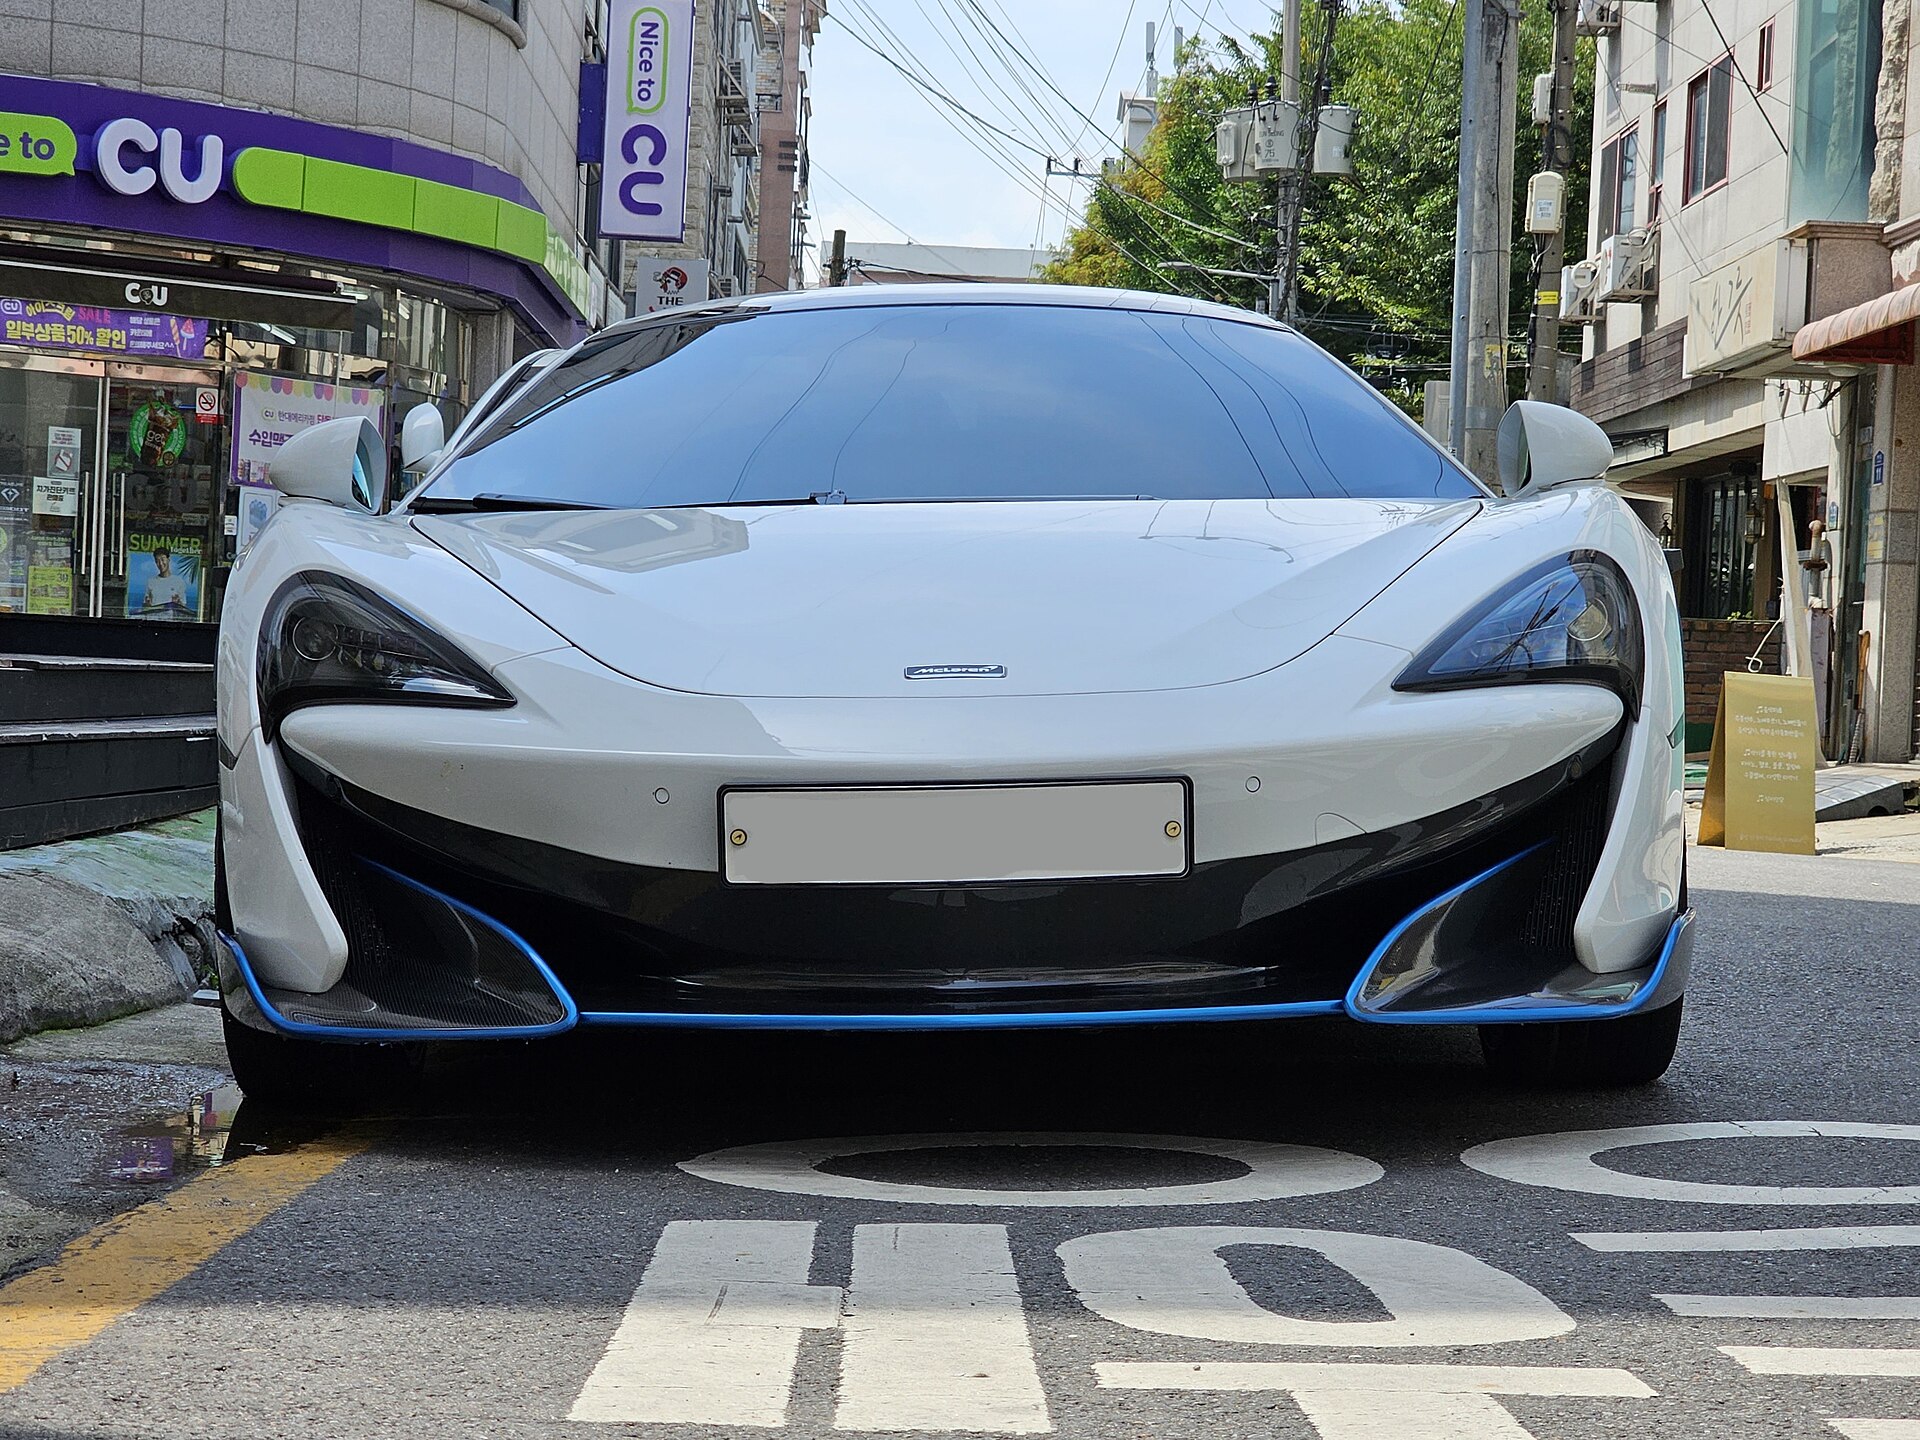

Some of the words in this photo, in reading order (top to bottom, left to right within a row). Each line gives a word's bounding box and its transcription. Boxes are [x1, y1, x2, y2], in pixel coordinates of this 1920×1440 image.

[637, 21, 661, 73] Nice
[637, 78, 656, 102] to
[19, 131, 56, 161] to
[96, 117, 224, 204] CU
[618, 123, 668, 217] CU
[4, 302, 18, 311] CU
[656, 295, 684, 306] THE
[78, 306, 111, 324] SALE
[6, 320, 66, 343] 일부상품
[66, 325, 94, 345] 50%
[95, 327, 126, 350] 할인
[145, 430, 166, 446] get
[129, 533, 201, 552] SUMMER
